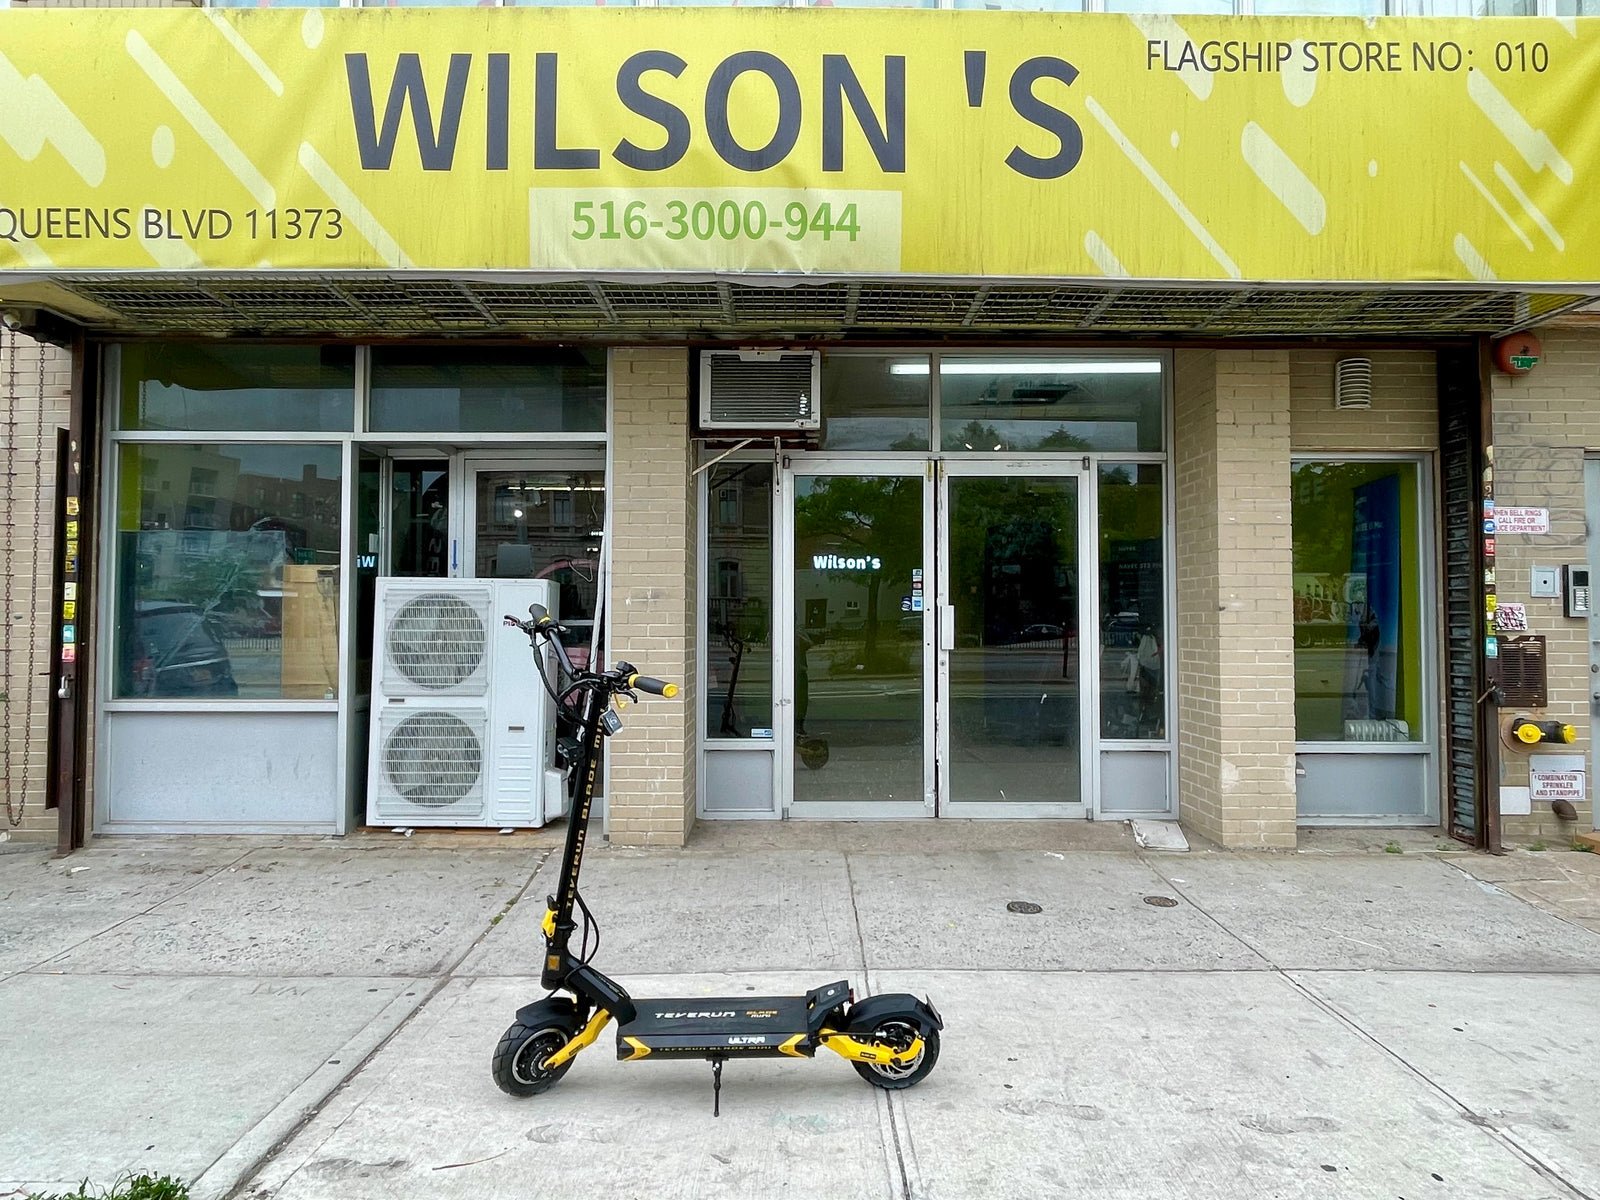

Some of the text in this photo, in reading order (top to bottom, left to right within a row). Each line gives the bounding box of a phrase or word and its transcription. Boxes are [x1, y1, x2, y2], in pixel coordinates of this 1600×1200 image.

[1147, 40, 1549, 74] FLAGSHIP STORE NO: 010
[344, 50, 906, 174] WILSON
[0, 207, 344, 242] QUEENS BLVD 11373
[571, 199, 861, 242] 516-3000-944
[812, 554, 881, 569] Wilson's
[581, 758, 597, 820] BLADE
[655, 1011, 736, 1019] TEVERUN
[728, 1036, 766, 1045] ULTRA
